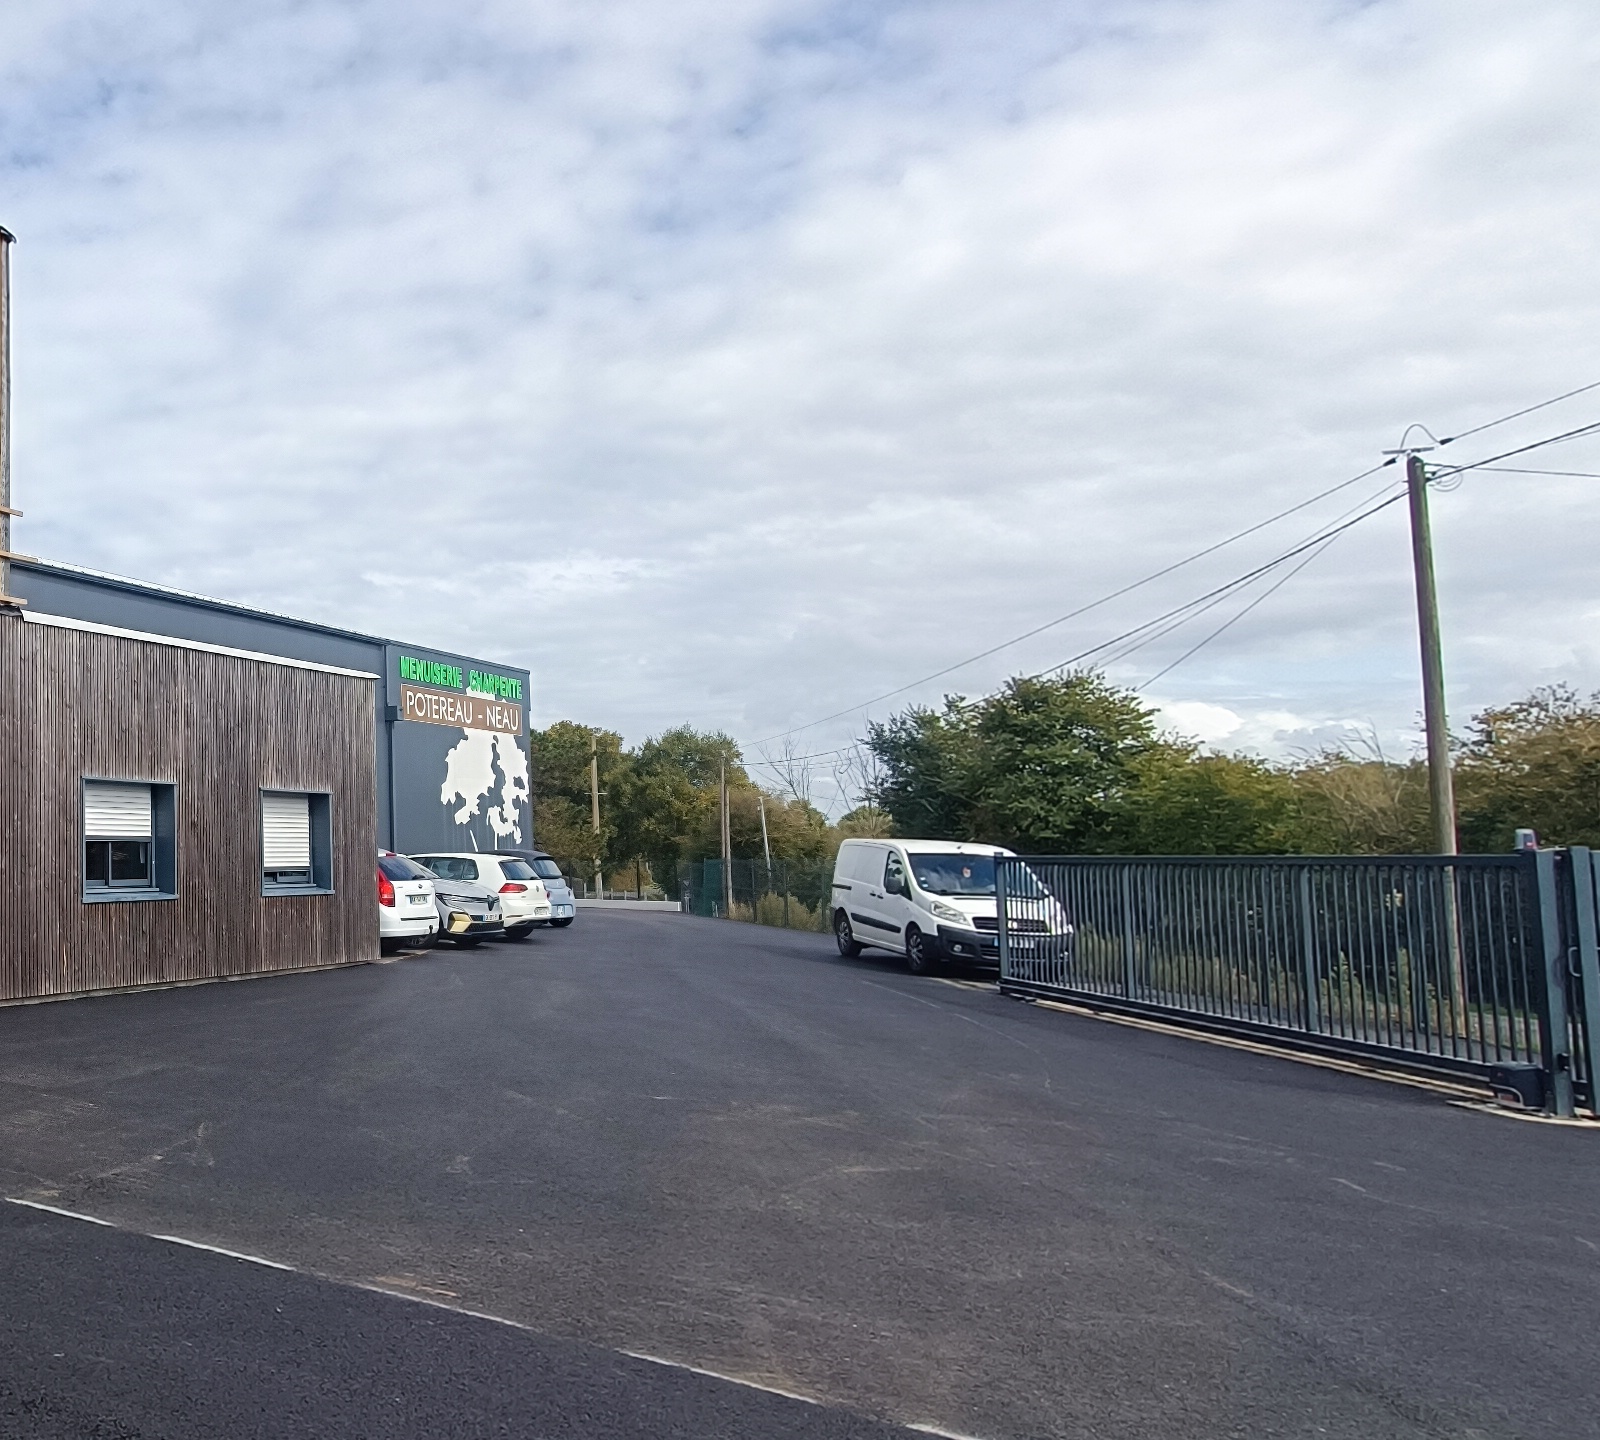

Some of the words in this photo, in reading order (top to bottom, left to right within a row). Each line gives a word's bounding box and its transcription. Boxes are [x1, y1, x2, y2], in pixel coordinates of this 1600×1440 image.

[400, 655, 463, 689] MENUISERIE
[469, 669, 523, 700] CHARPENTE
[406, 691, 473, 724] POTEREAU
[486, 705, 519, 731] NEAU
